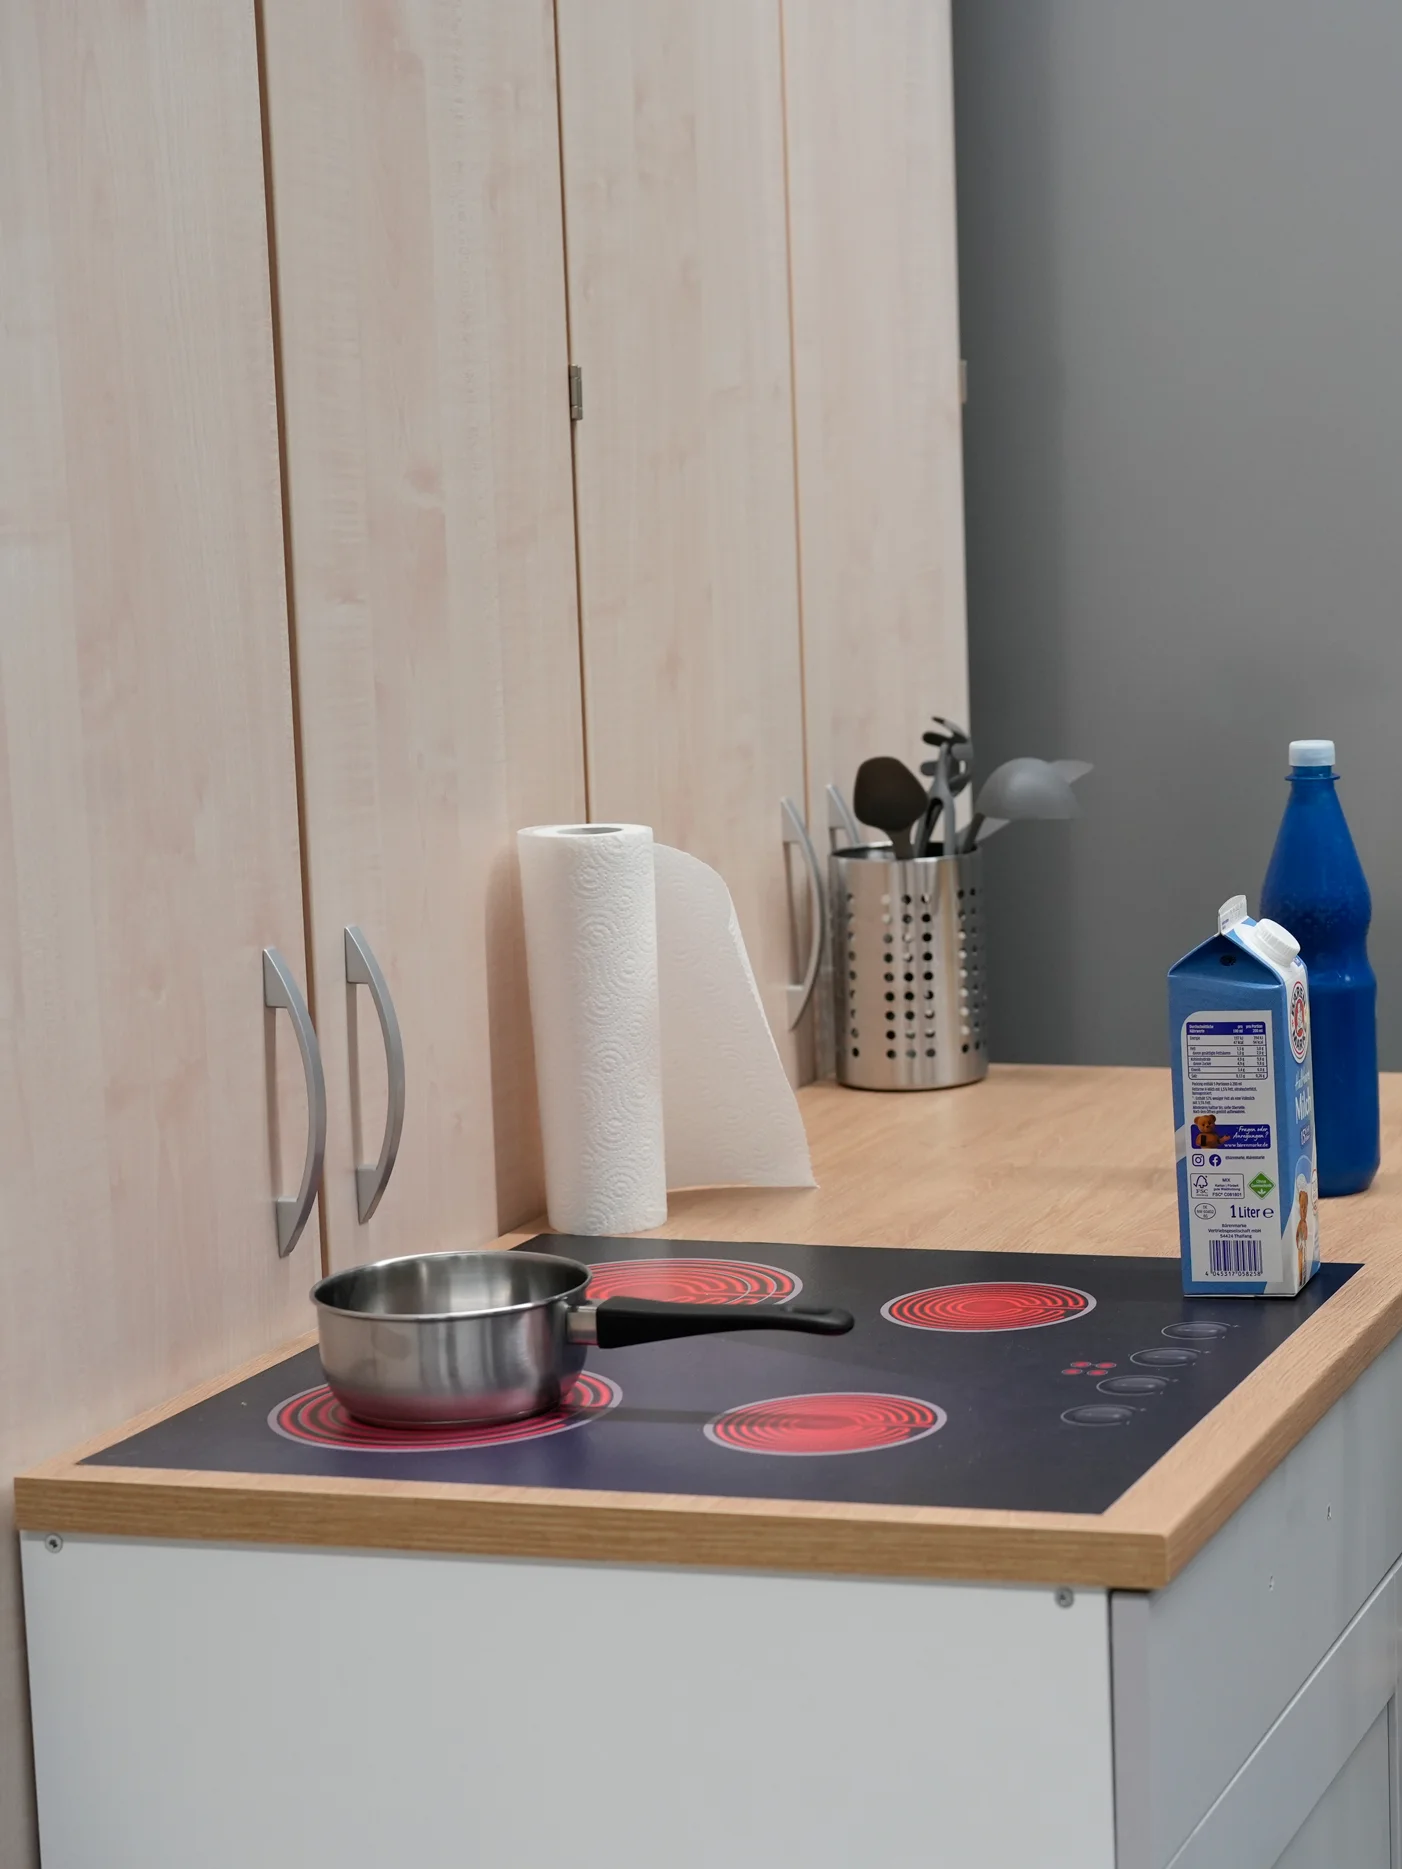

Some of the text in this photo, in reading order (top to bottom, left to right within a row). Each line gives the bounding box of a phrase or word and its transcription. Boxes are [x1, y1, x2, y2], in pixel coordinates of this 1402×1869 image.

[1295, 1087, 1312, 1124] Milch
[1238, 1126, 1256, 1134] Fragen
[1230, 1204, 1236, 1218] 1
[1238, 1207, 1260, 1218] Liter
